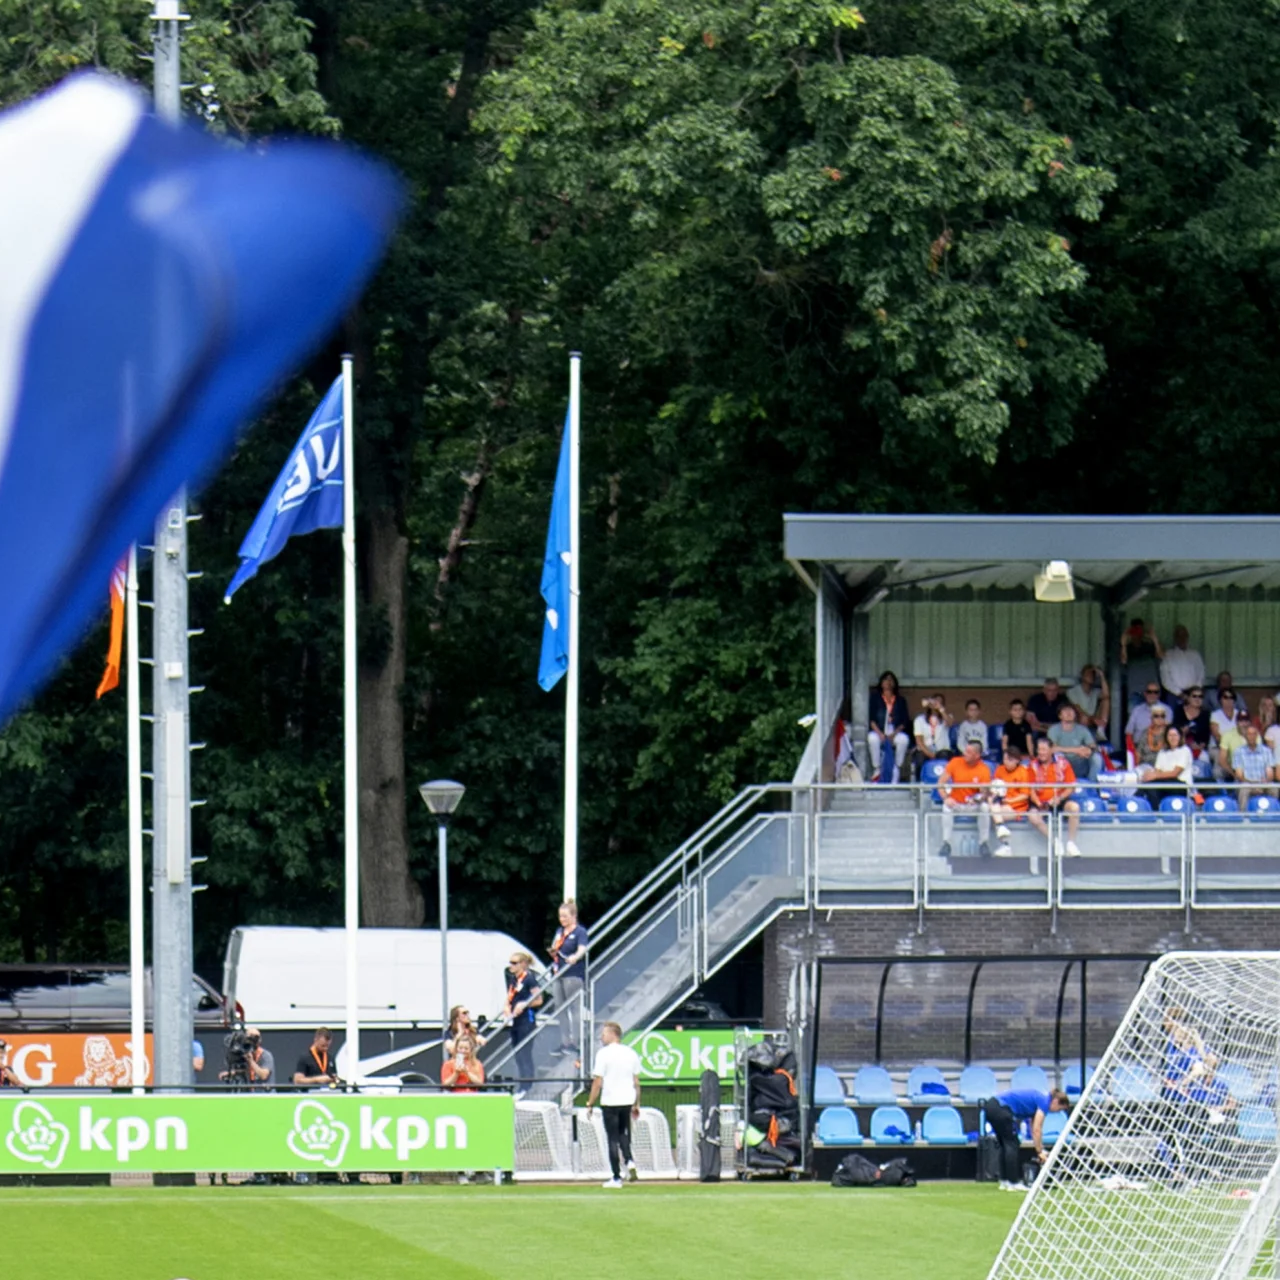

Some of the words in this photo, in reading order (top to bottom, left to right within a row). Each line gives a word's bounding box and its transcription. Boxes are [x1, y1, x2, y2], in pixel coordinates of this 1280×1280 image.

[690, 1036, 736, 1079] kp
[79, 1105, 188, 1163] kpn
[359, 1104, 468, 1161] kpn
